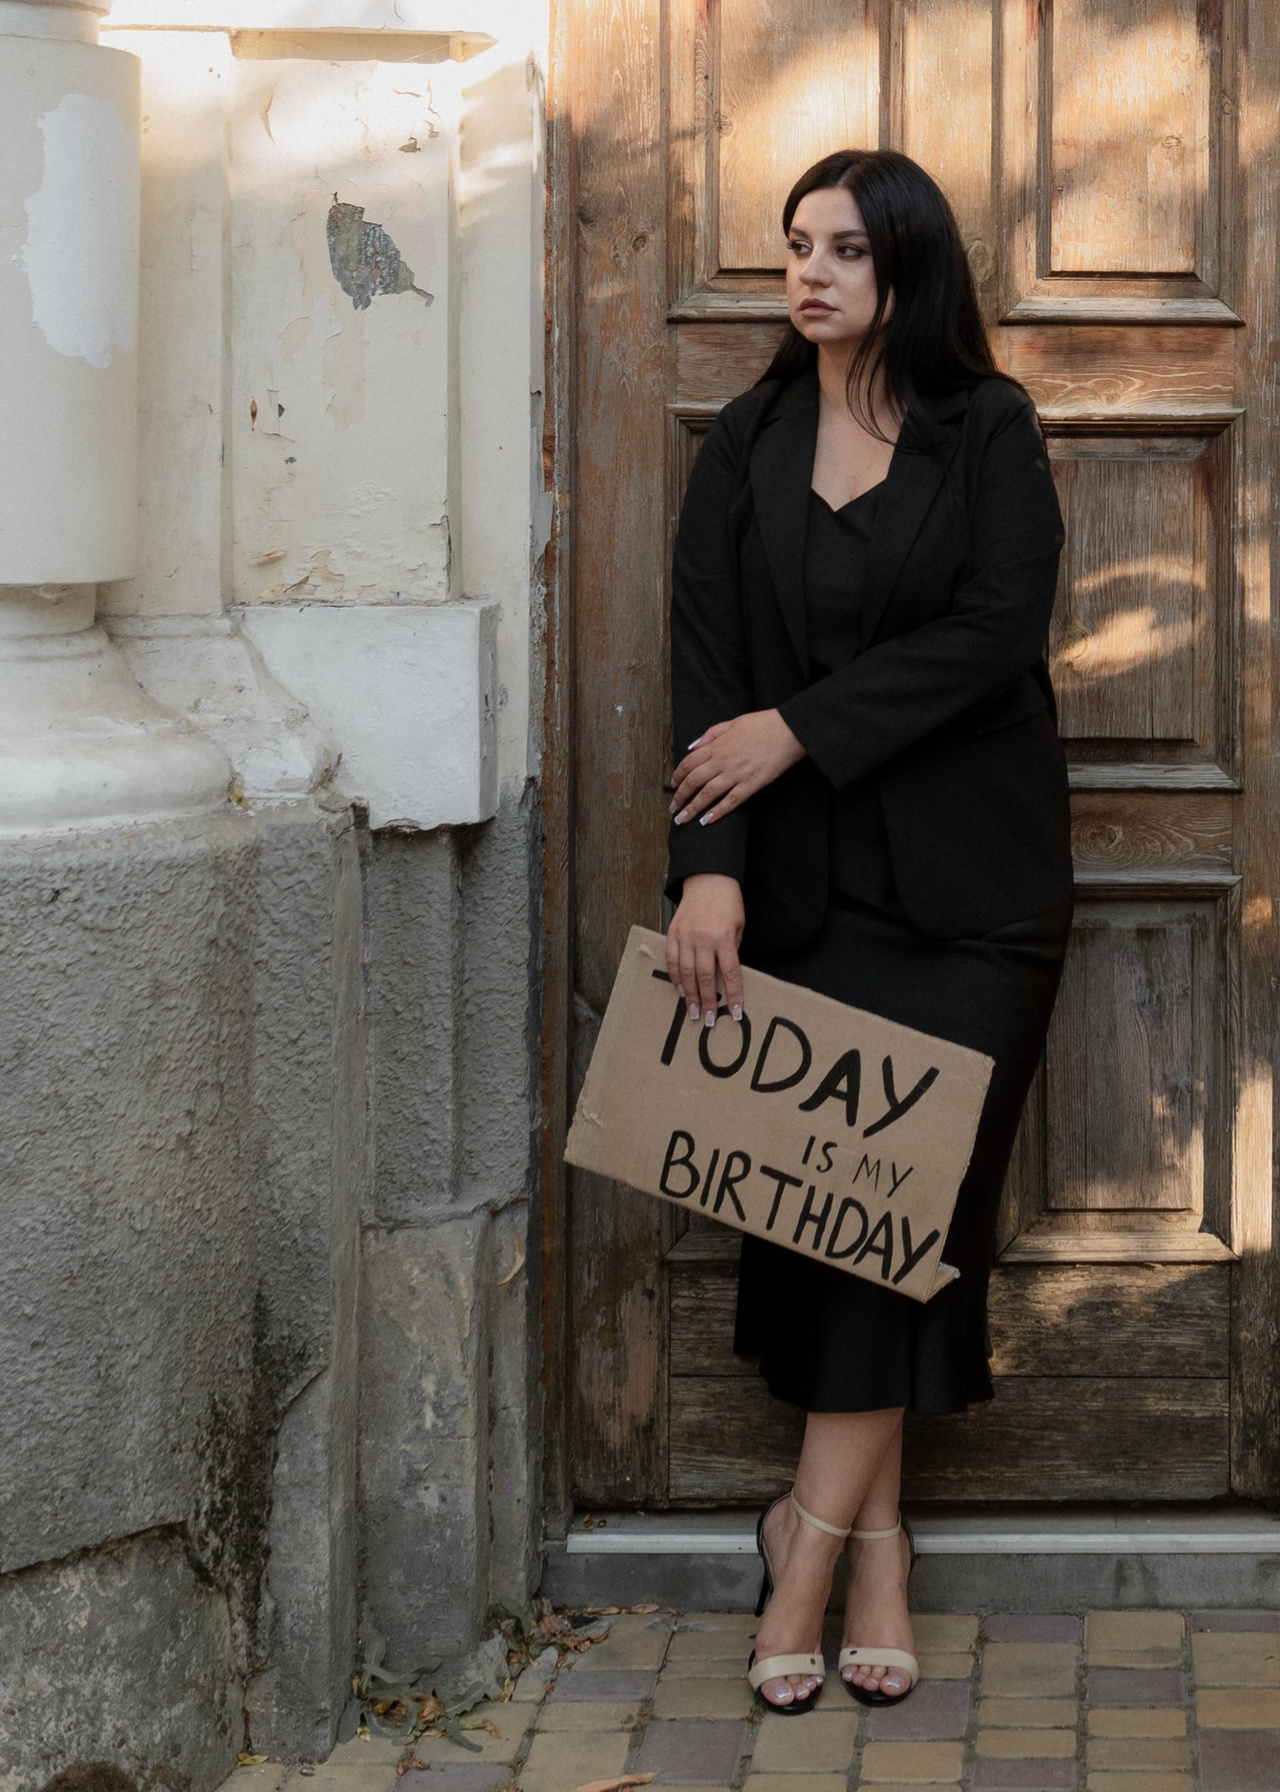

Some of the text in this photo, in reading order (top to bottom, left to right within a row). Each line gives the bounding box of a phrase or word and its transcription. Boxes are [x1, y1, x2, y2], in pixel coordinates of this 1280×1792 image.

[652, 969, 940, 1138] TODAY
[659, 1130, 940, 1285] BIRTHDAY
[802, 1135, 914, 1197] IS MY
